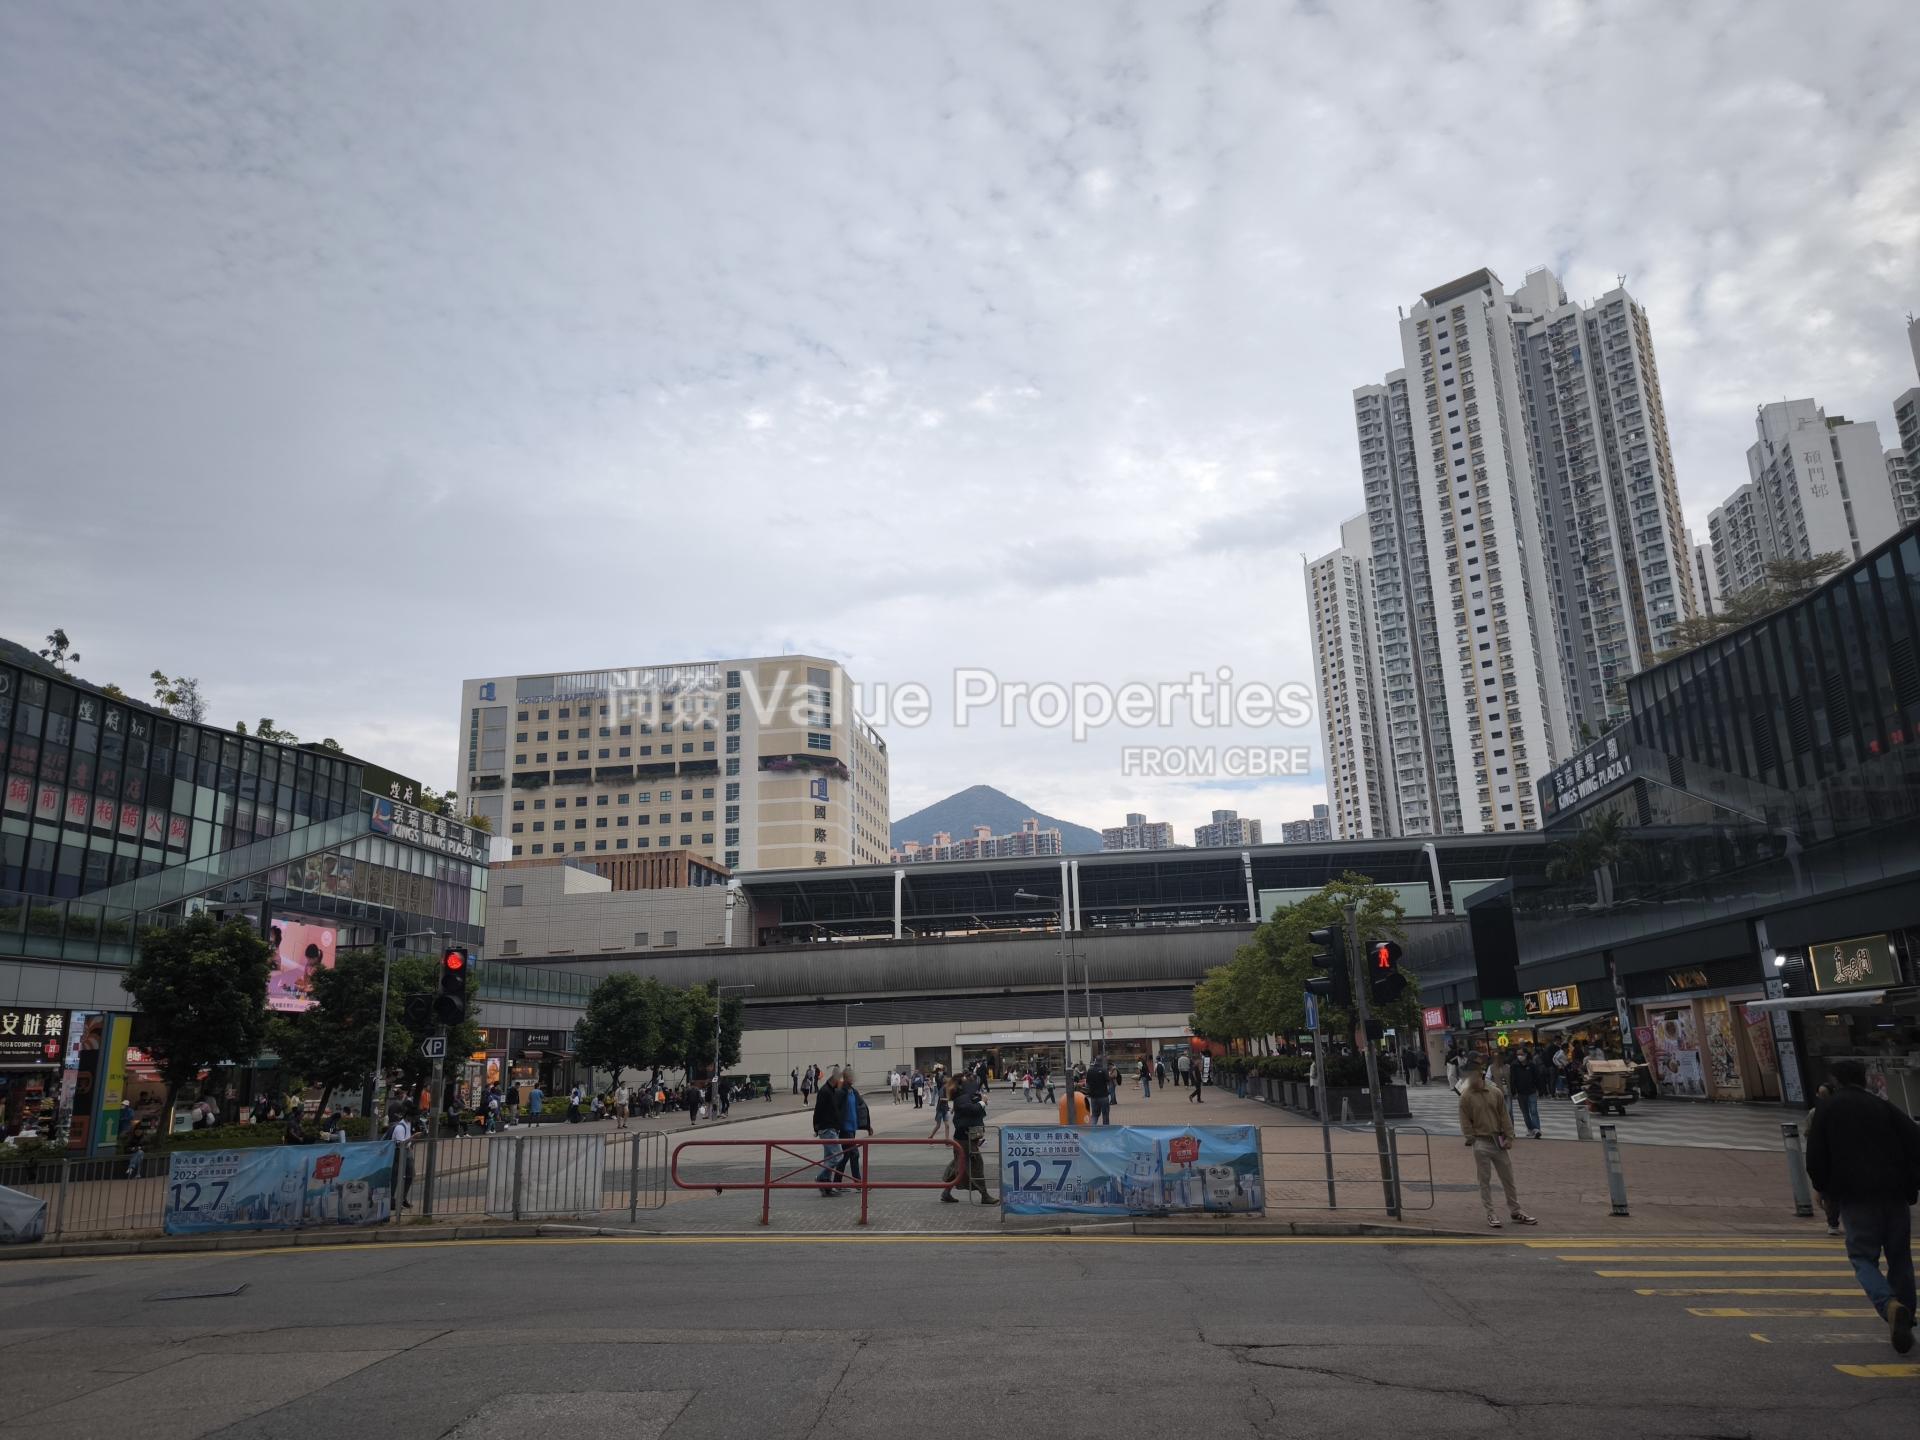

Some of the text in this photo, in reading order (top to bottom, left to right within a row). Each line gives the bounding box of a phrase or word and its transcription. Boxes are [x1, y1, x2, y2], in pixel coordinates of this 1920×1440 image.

[1557, 754, 1633, 811] KINGS WING PLAZA 1
[392, 823, 482, 861] KINGS WING PLAZA 2
[433, 1041, 443, 1054] P
[1007, 1147, 1035, 1157] 2025
[173, 1170, 197, 1181] 2025
